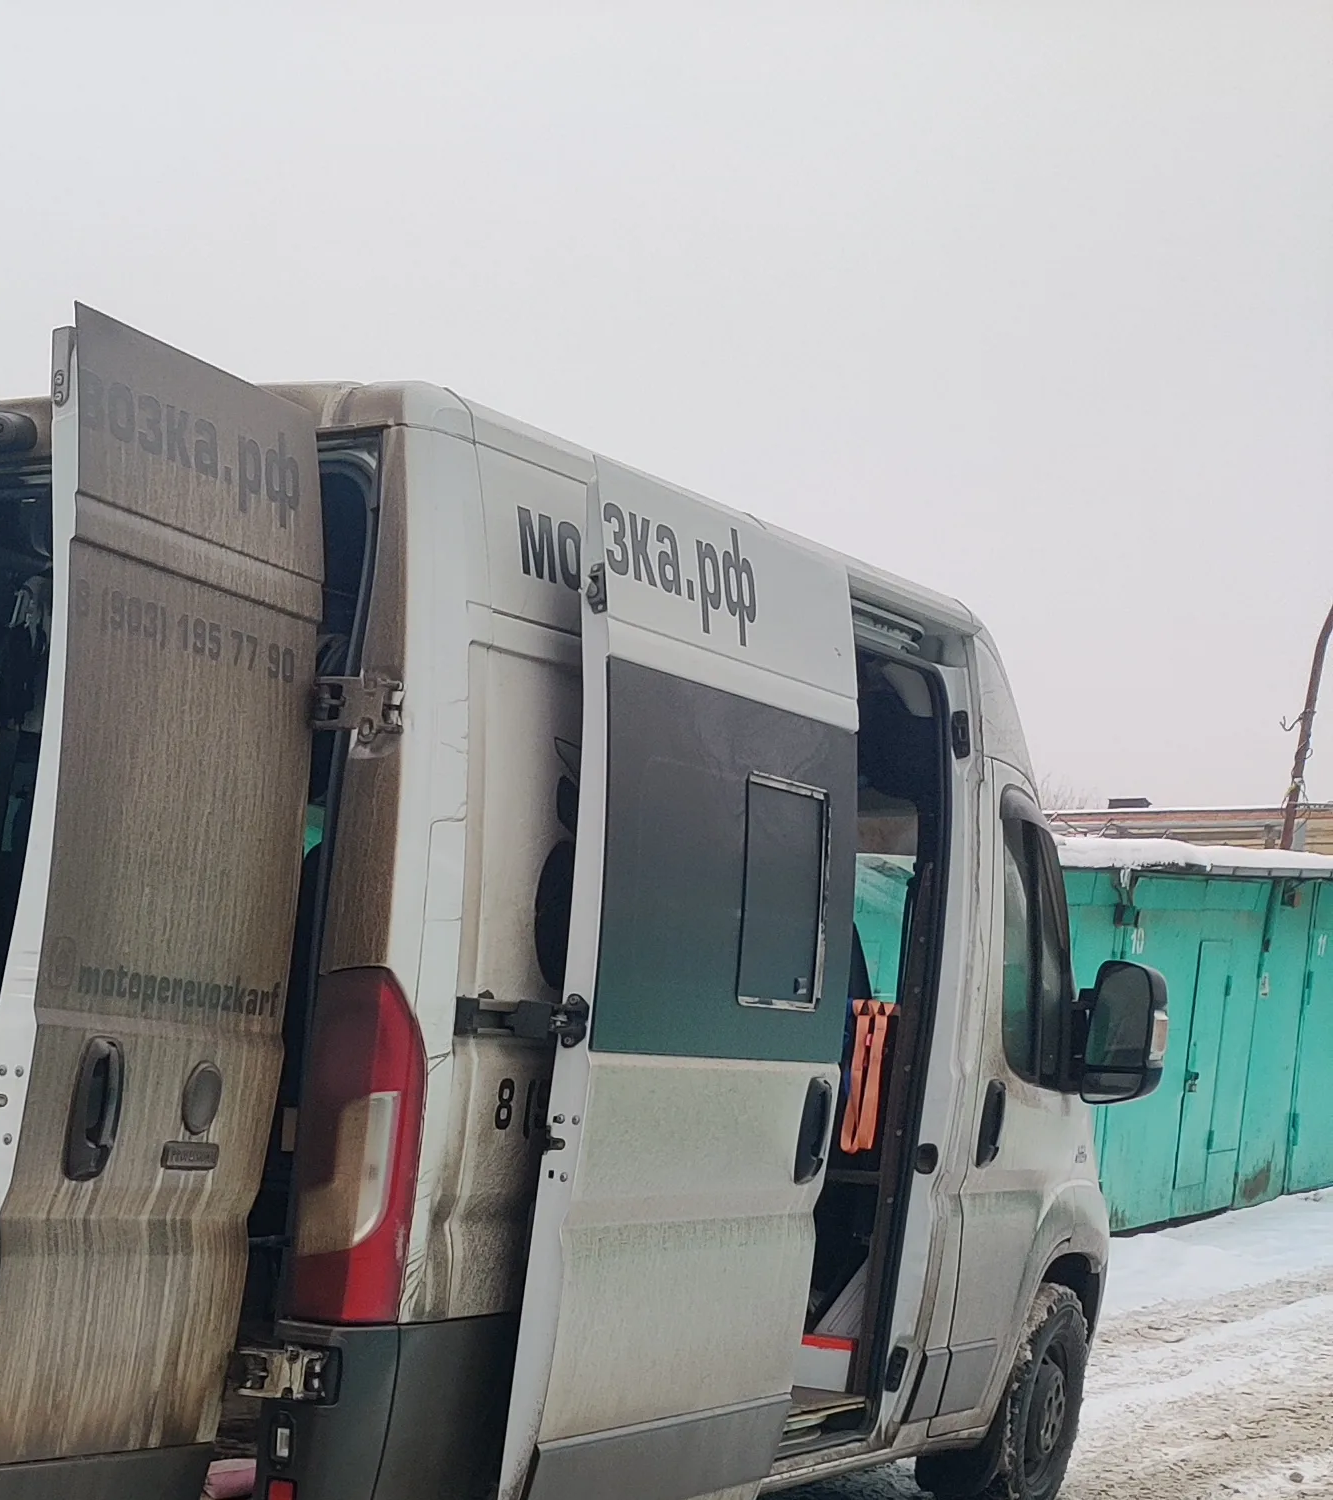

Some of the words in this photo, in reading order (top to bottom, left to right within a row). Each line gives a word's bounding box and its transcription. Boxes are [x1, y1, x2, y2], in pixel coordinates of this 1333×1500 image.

[177, 613, 221, 662] 195
[230, 629, 258, 671] 77
[267, 642, 295, 683] 90
[1131, 927, 1145, 955] 10
[495, 1078, 515, 1130] 8
